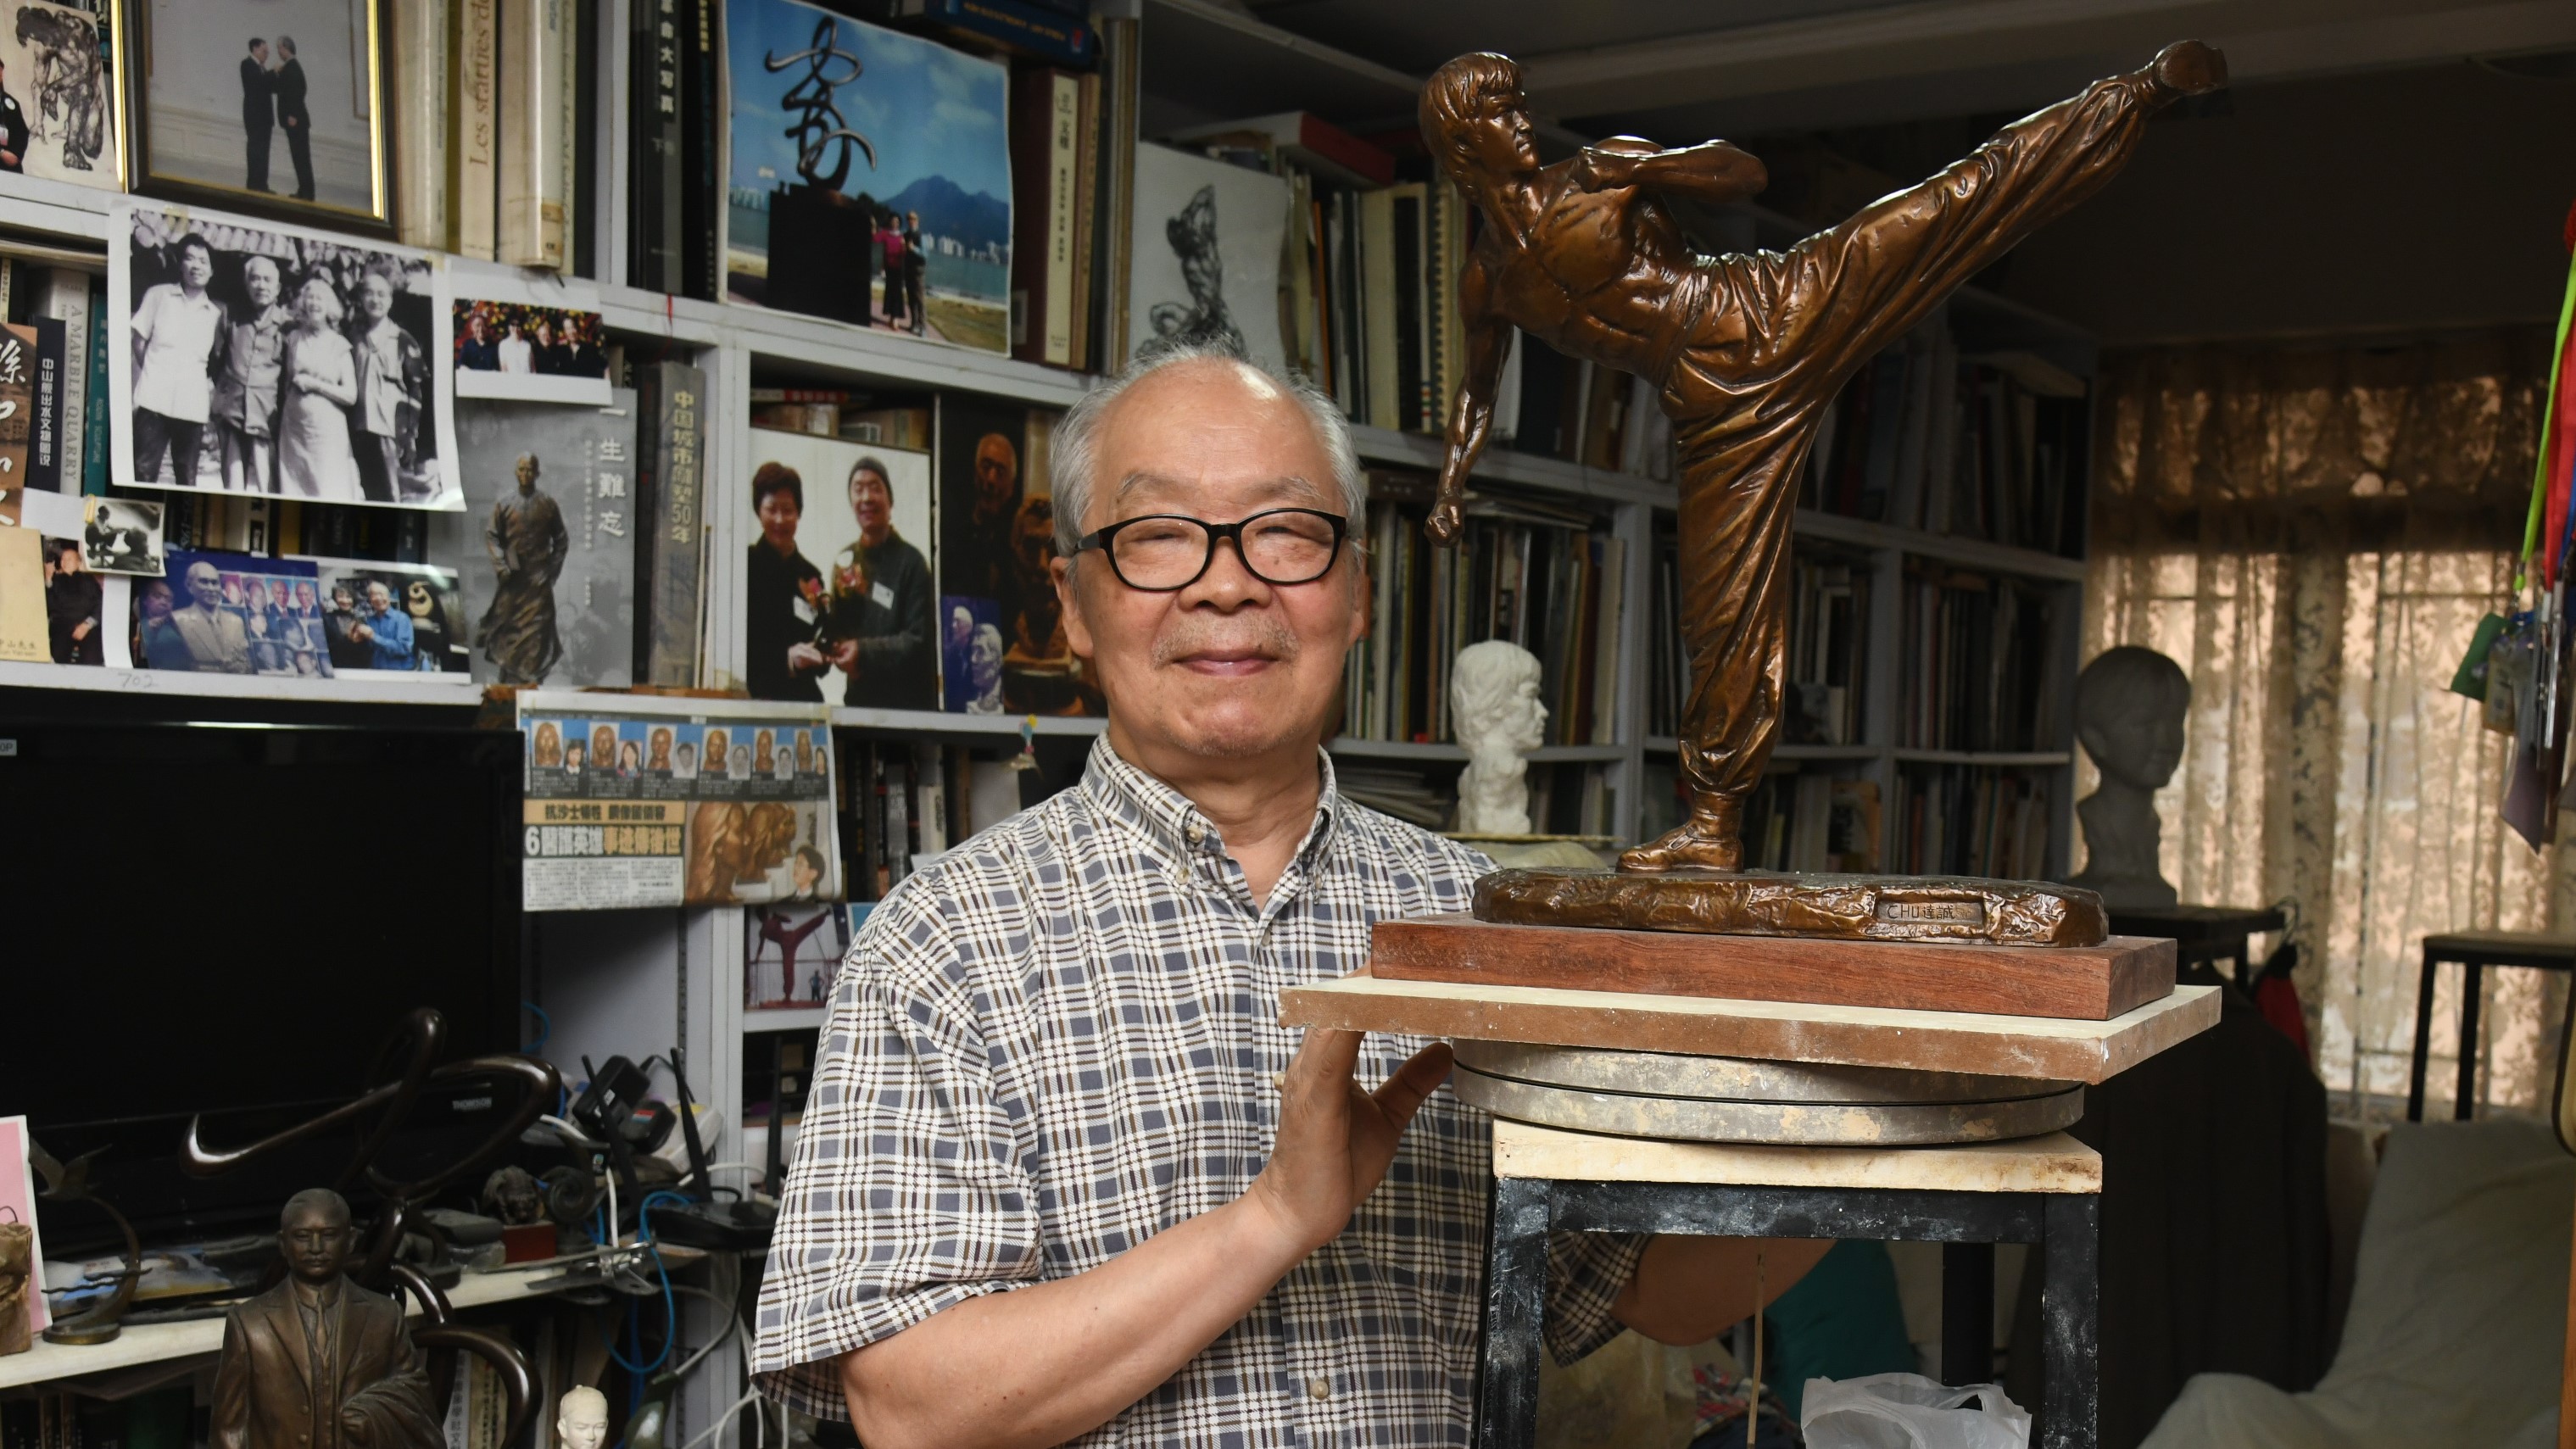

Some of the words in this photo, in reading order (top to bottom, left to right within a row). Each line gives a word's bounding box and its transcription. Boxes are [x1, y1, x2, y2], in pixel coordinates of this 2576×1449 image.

[476, 30, 490, 114] statues
[71, 305, 83, 317] A
[67, 323, 82, 398] MARBLE
[64, 404, 81, 480] QUARRY
[599, 407, 627, 537] 一生難忘
